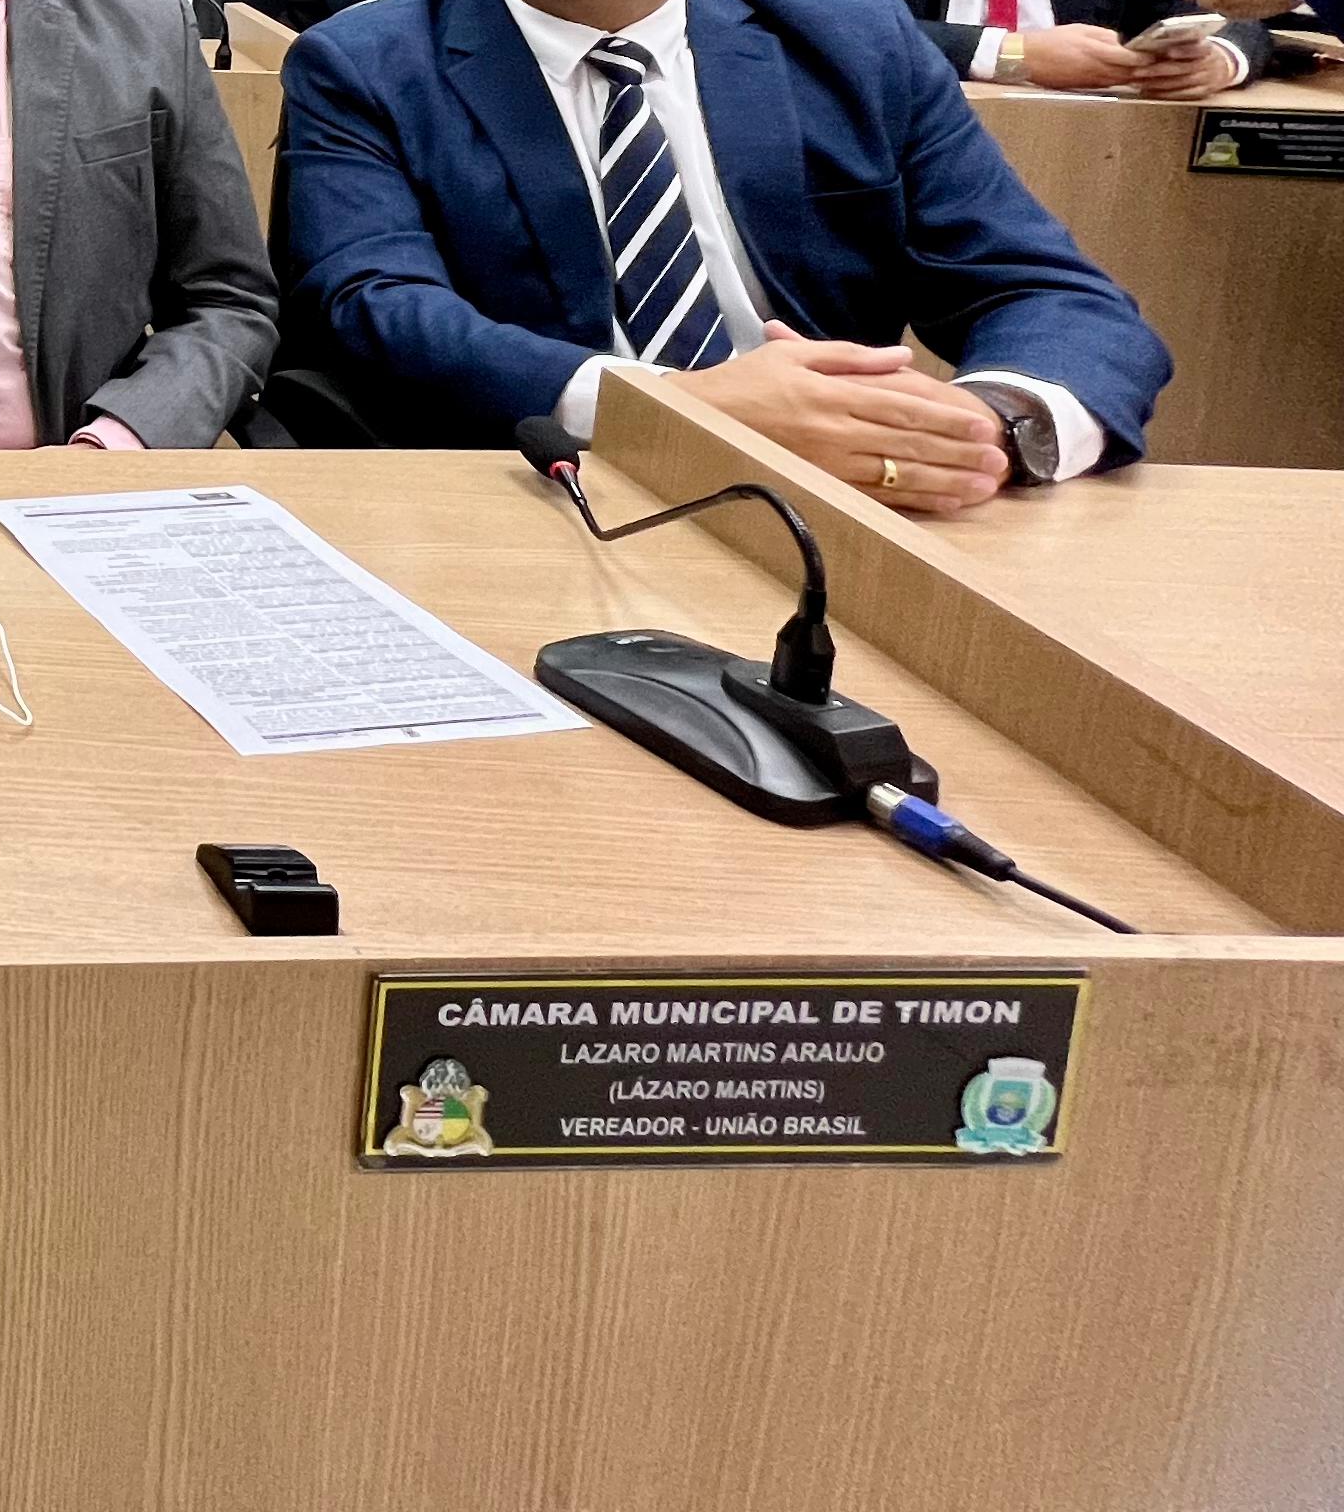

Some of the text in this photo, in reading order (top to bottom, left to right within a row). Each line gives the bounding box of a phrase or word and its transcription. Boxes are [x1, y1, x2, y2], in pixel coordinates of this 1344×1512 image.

[438, 997, 1022, 1027] CÂMARA MUNICIPAL DE TIMON
[560, 1041, 887, 1065] LAZARO MARTINS ARAUJO
[608, 1075, 826, 1105] (LÁZARO MARTINS)
[560, 1116, 686, 1138] VEREADOR
[704, 1112, 778, 1137] UNIÃO
[783, 1115, 867, 1136] BRASIL
